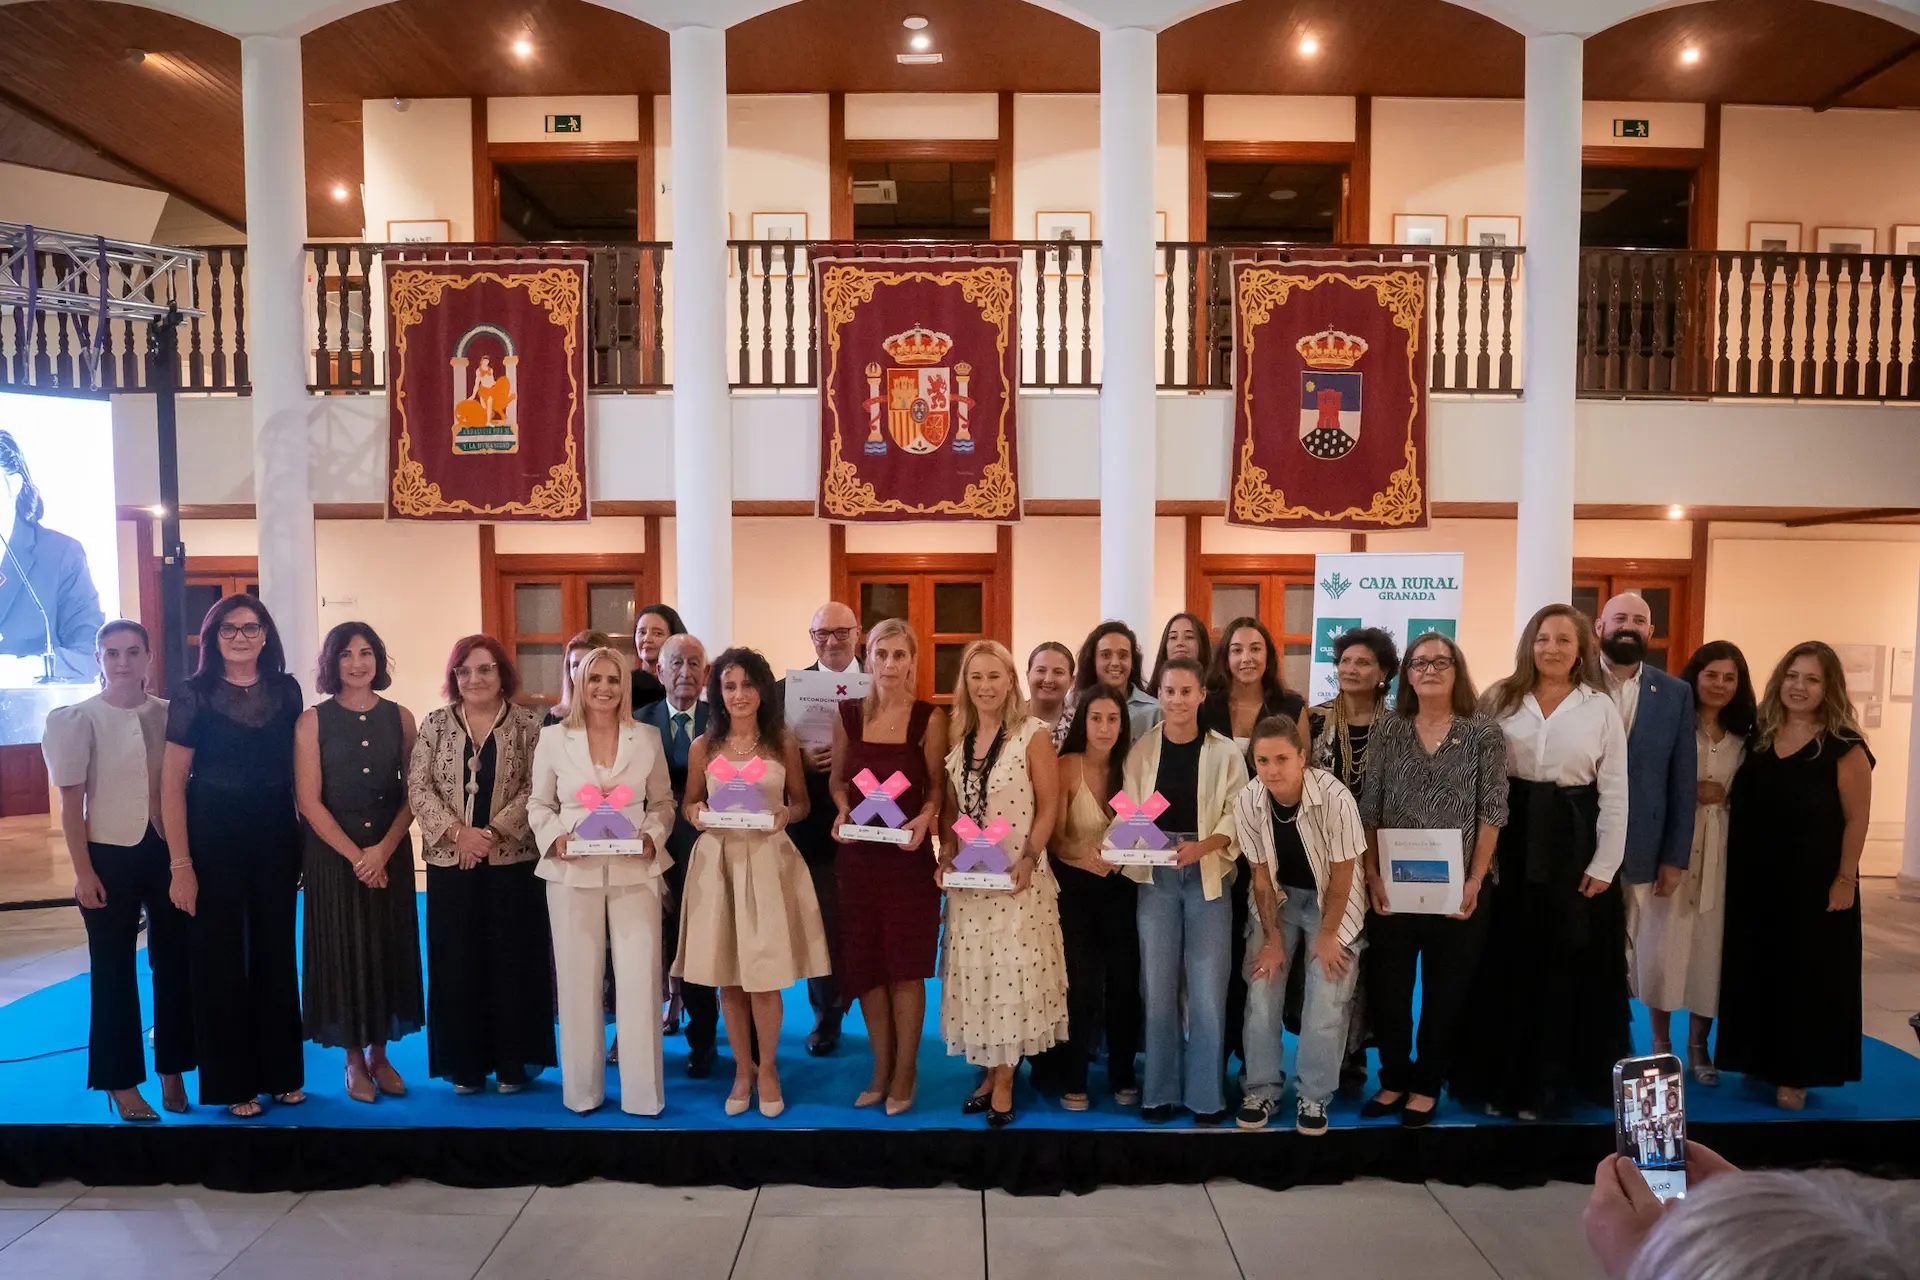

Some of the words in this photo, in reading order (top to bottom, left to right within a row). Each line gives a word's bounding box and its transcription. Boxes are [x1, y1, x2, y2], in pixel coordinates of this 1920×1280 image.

[1359, 577, 1397, 590] CAJA
[1402, 577, 1458, 590] RURAL
[1378, 591, 1436, 601] GRANADA
